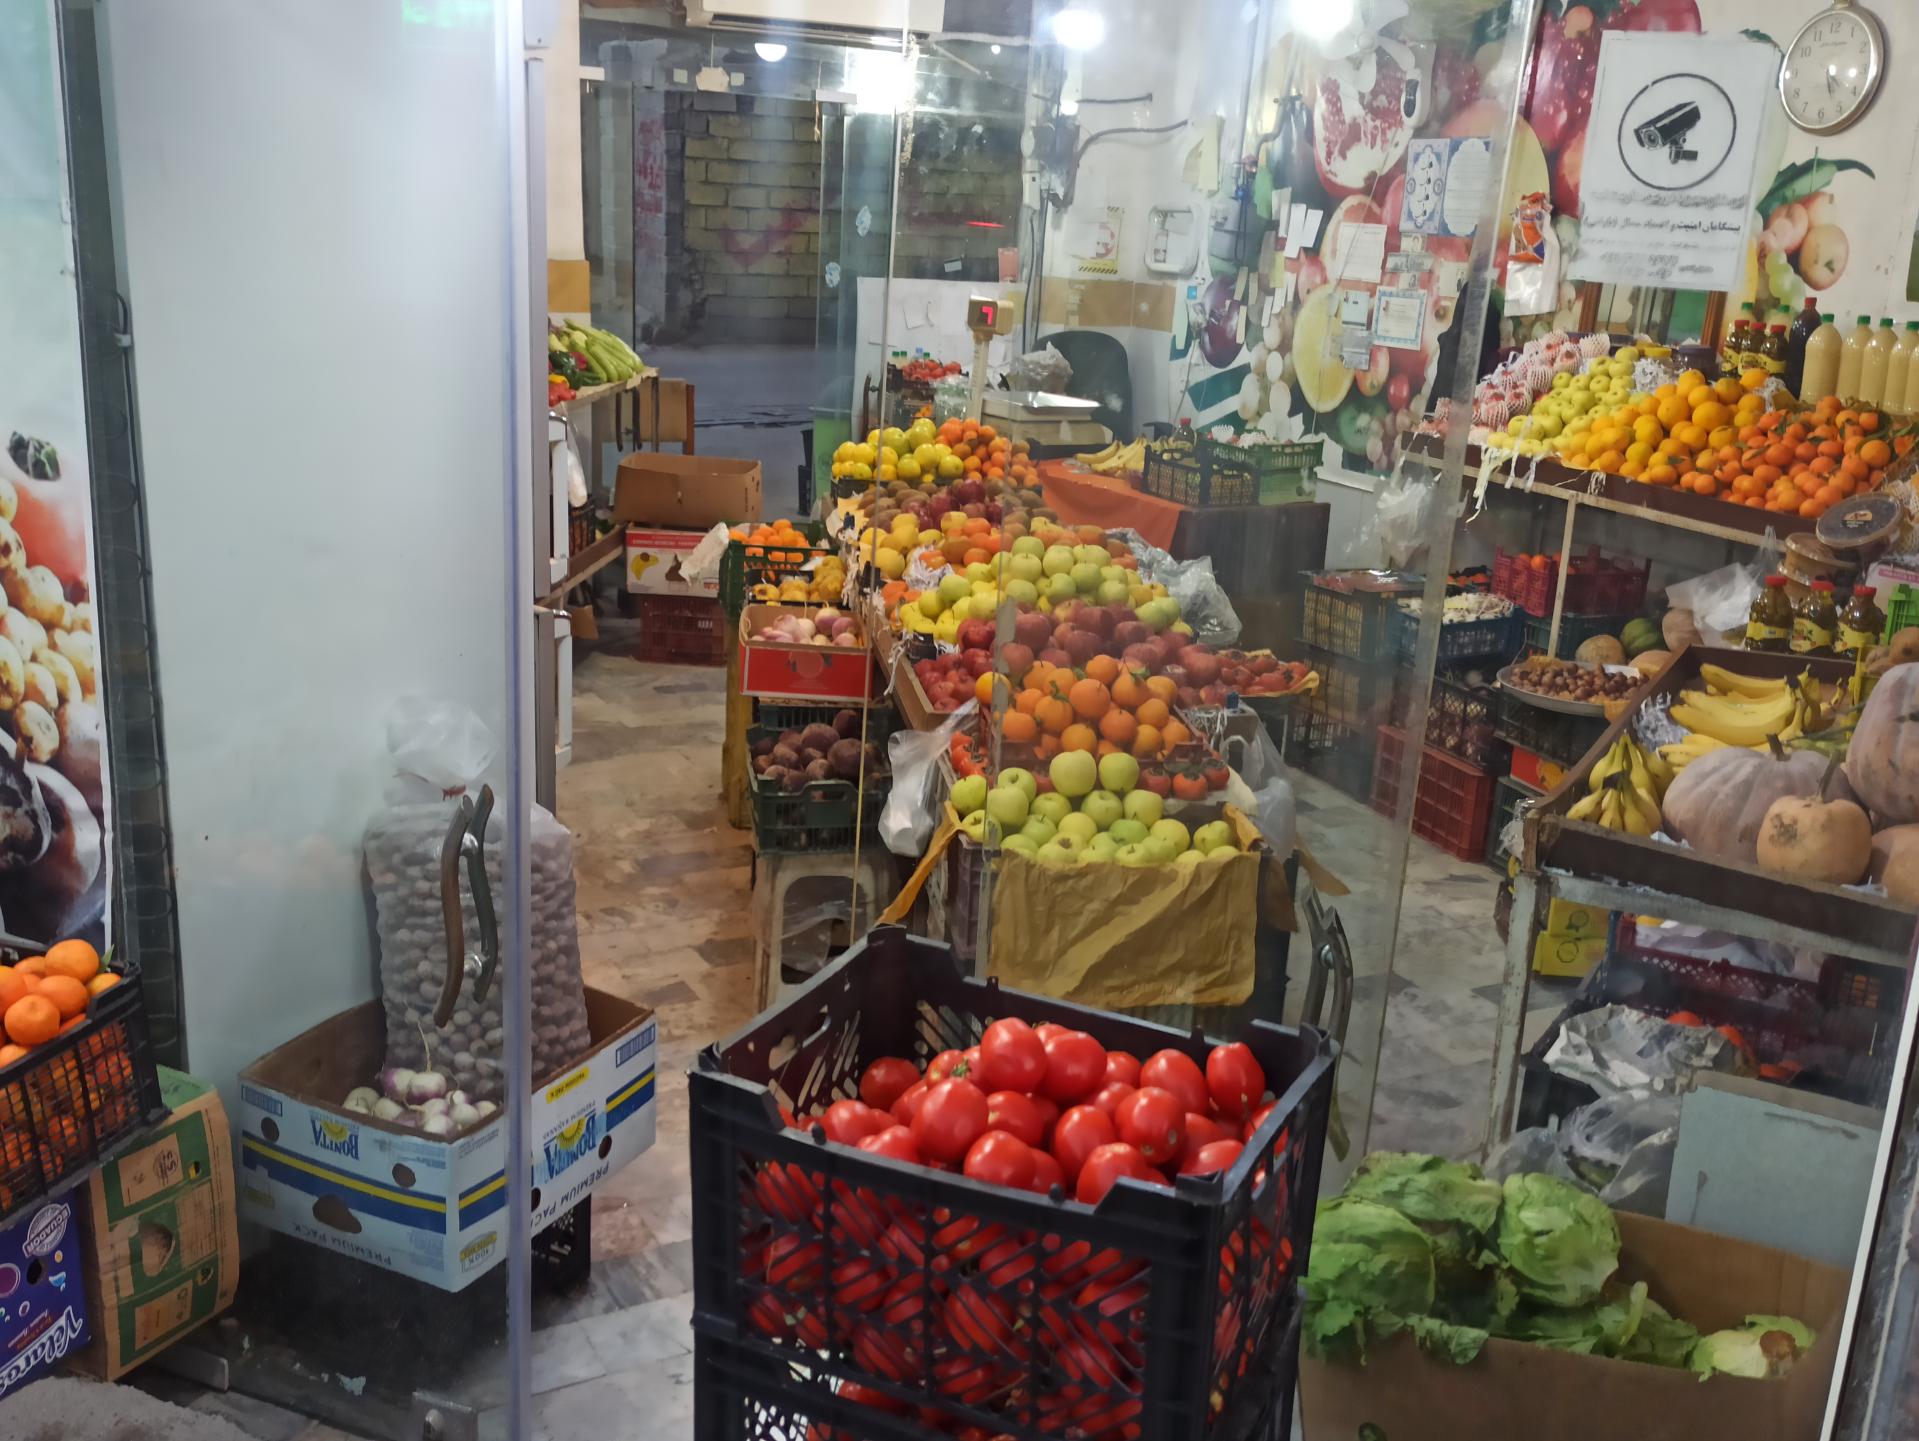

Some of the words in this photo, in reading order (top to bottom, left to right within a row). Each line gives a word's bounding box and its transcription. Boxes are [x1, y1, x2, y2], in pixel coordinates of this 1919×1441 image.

[1830, 22, 1842, 33] 12
[1850, 25, 1855, 38] 1
[1813, 31, 1822, 41] 11
[1800, 46, 1812, 58] 10
[1793, 88, 1800, 99] 8
[1850, 86, 1857, 97] 4
[1801, 102, 1808, 113] 7
[1818, 107, 1825, 119] 6
[1836, 101, 1843, 113] 5
[311, 1118, 360, 1161] BONITA
[543, 1112, 597, 1181] BONITA
[560, 1160, 609, 1207] PREMIUM
[26, 1208, 68, 1253] ECUADOR
[292, 1222, 328, 1247] PACK
[331, 1235, 392, 1267] PREMIUM
